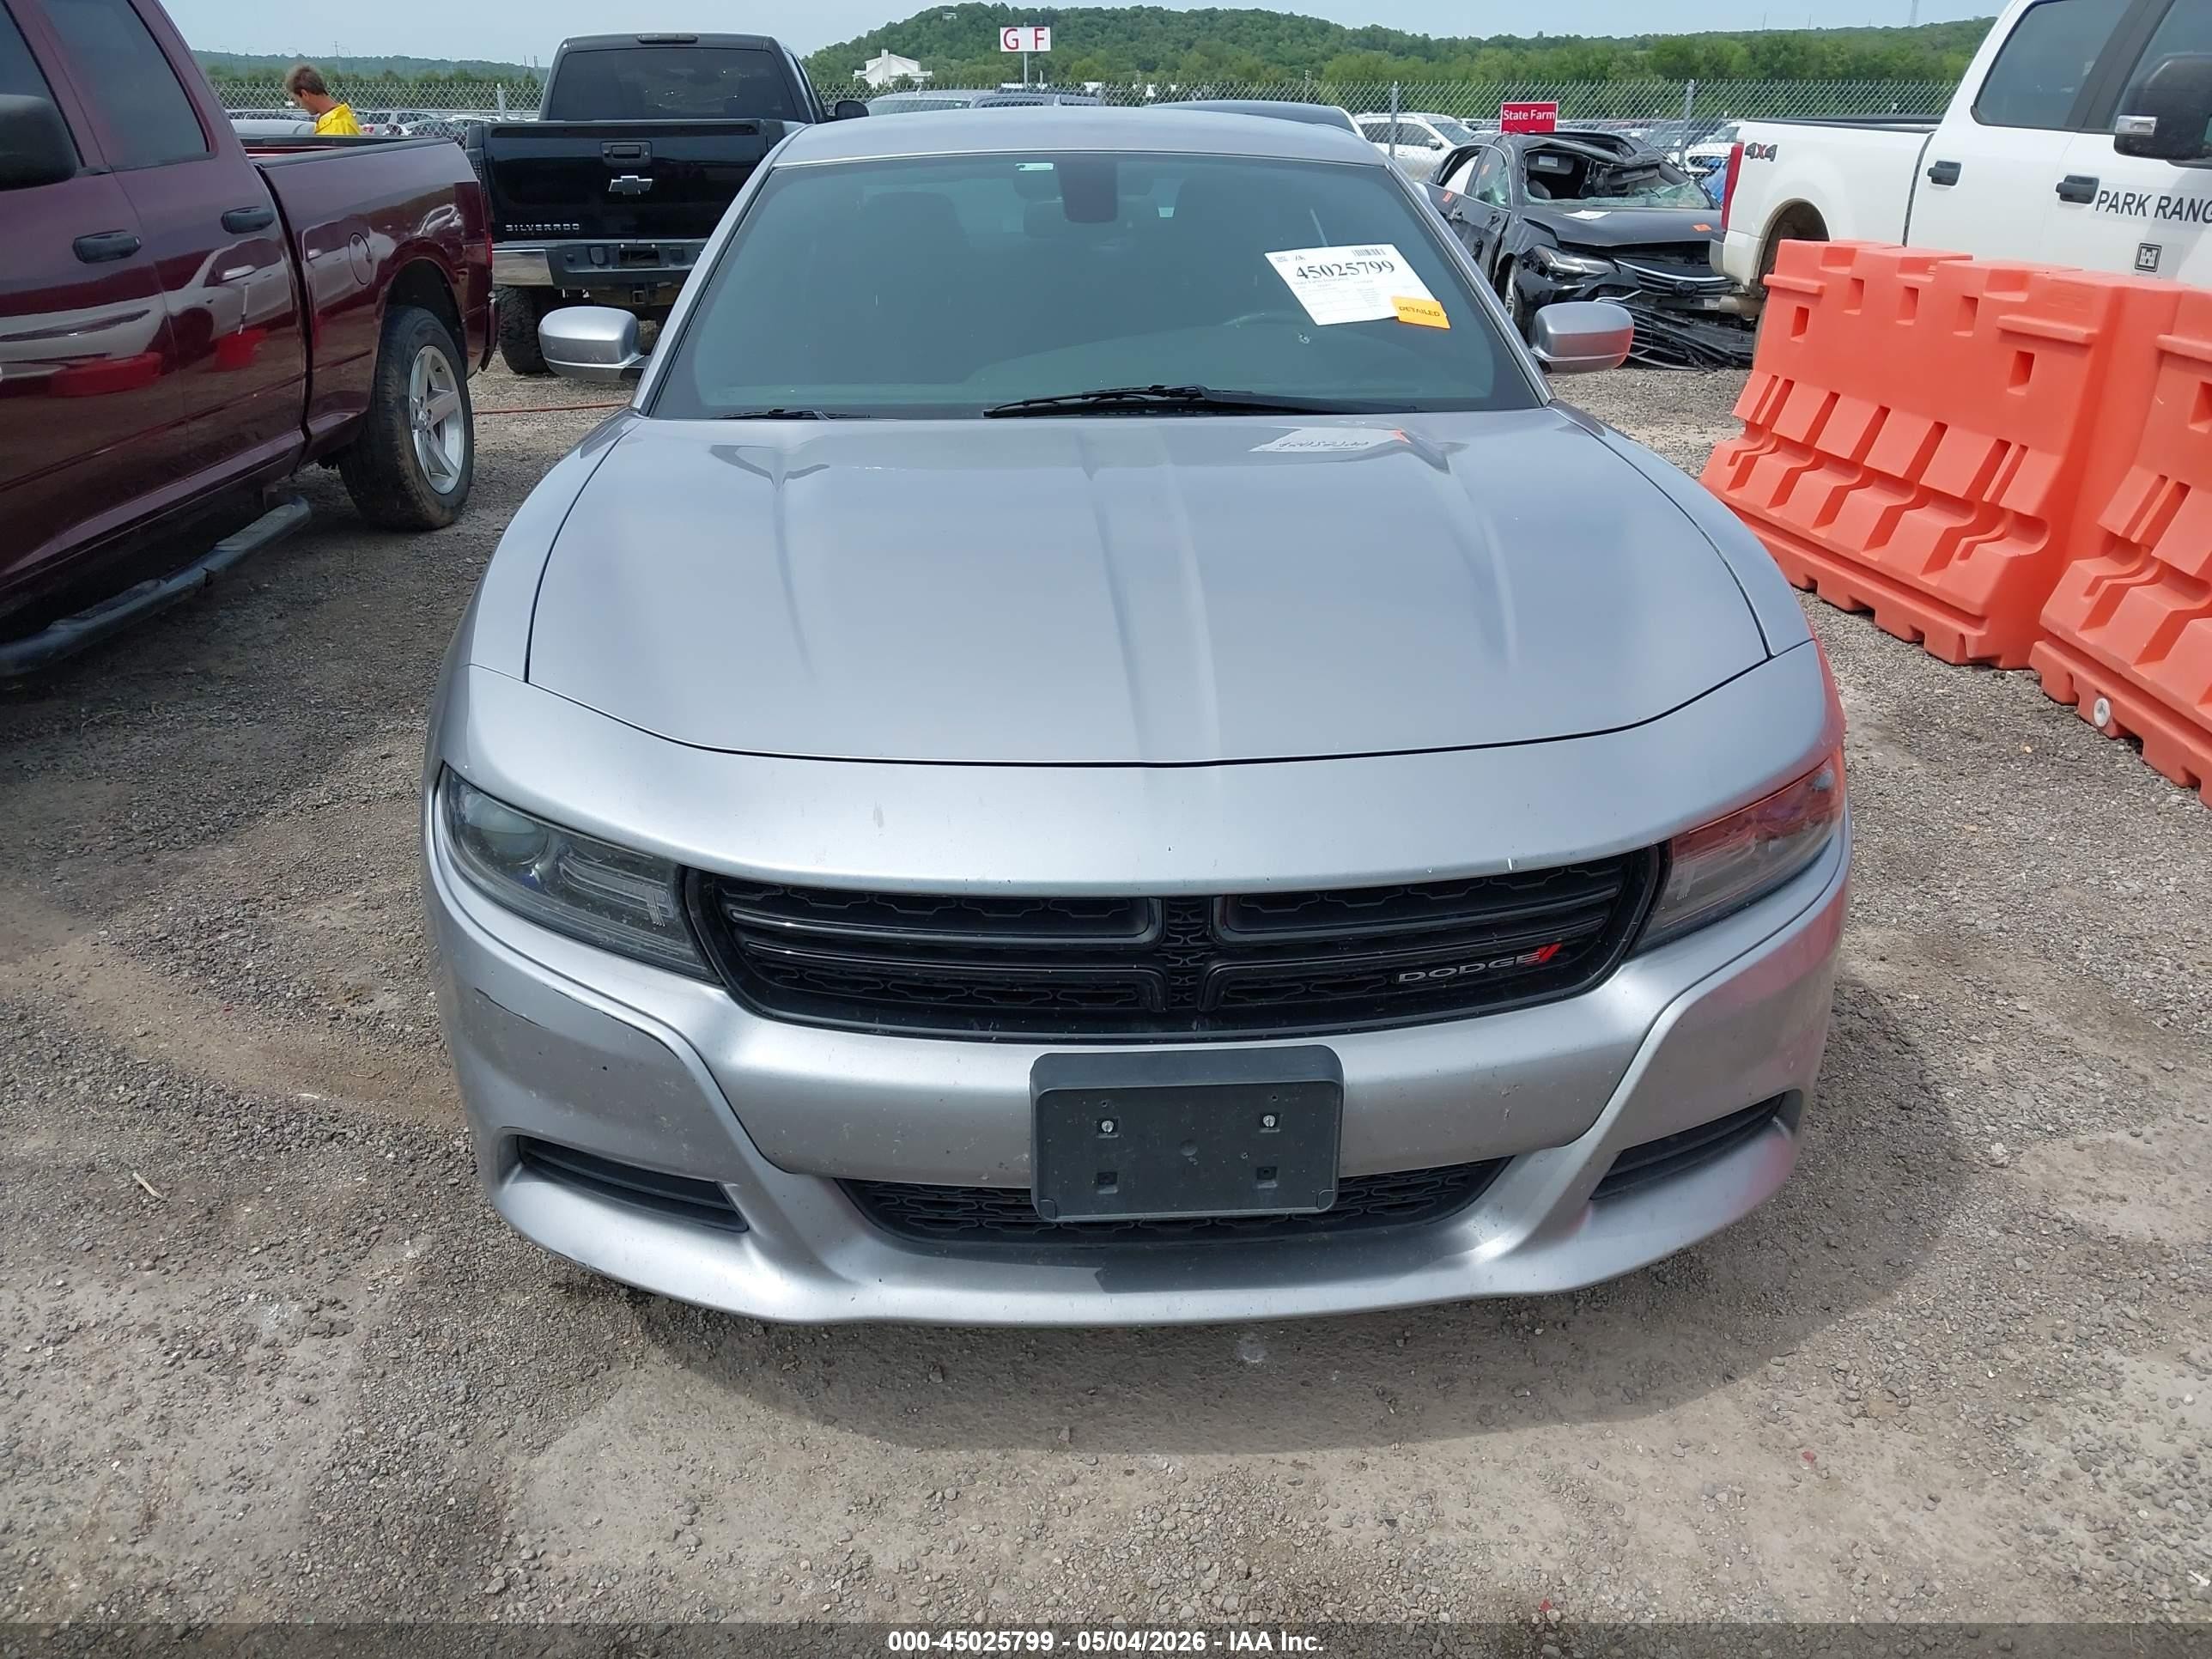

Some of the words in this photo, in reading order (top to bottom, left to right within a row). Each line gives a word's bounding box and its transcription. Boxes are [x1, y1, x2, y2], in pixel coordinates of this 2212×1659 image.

[1003, 27, 1019, 50] G
[1034, 27, 1045, 50] F
[1503, 109, 1528, 120] State
[1530, 109, 1555, 120] Farm
[2095, 190, 2153, 217] PARK
[505, 223, 580, 232] SILVERADO
[1296, 259, 1395, 279] 45025799
[1398, 306, 1441, 317] DETAILED
[1398, 951, 1540, 983] DODGE
